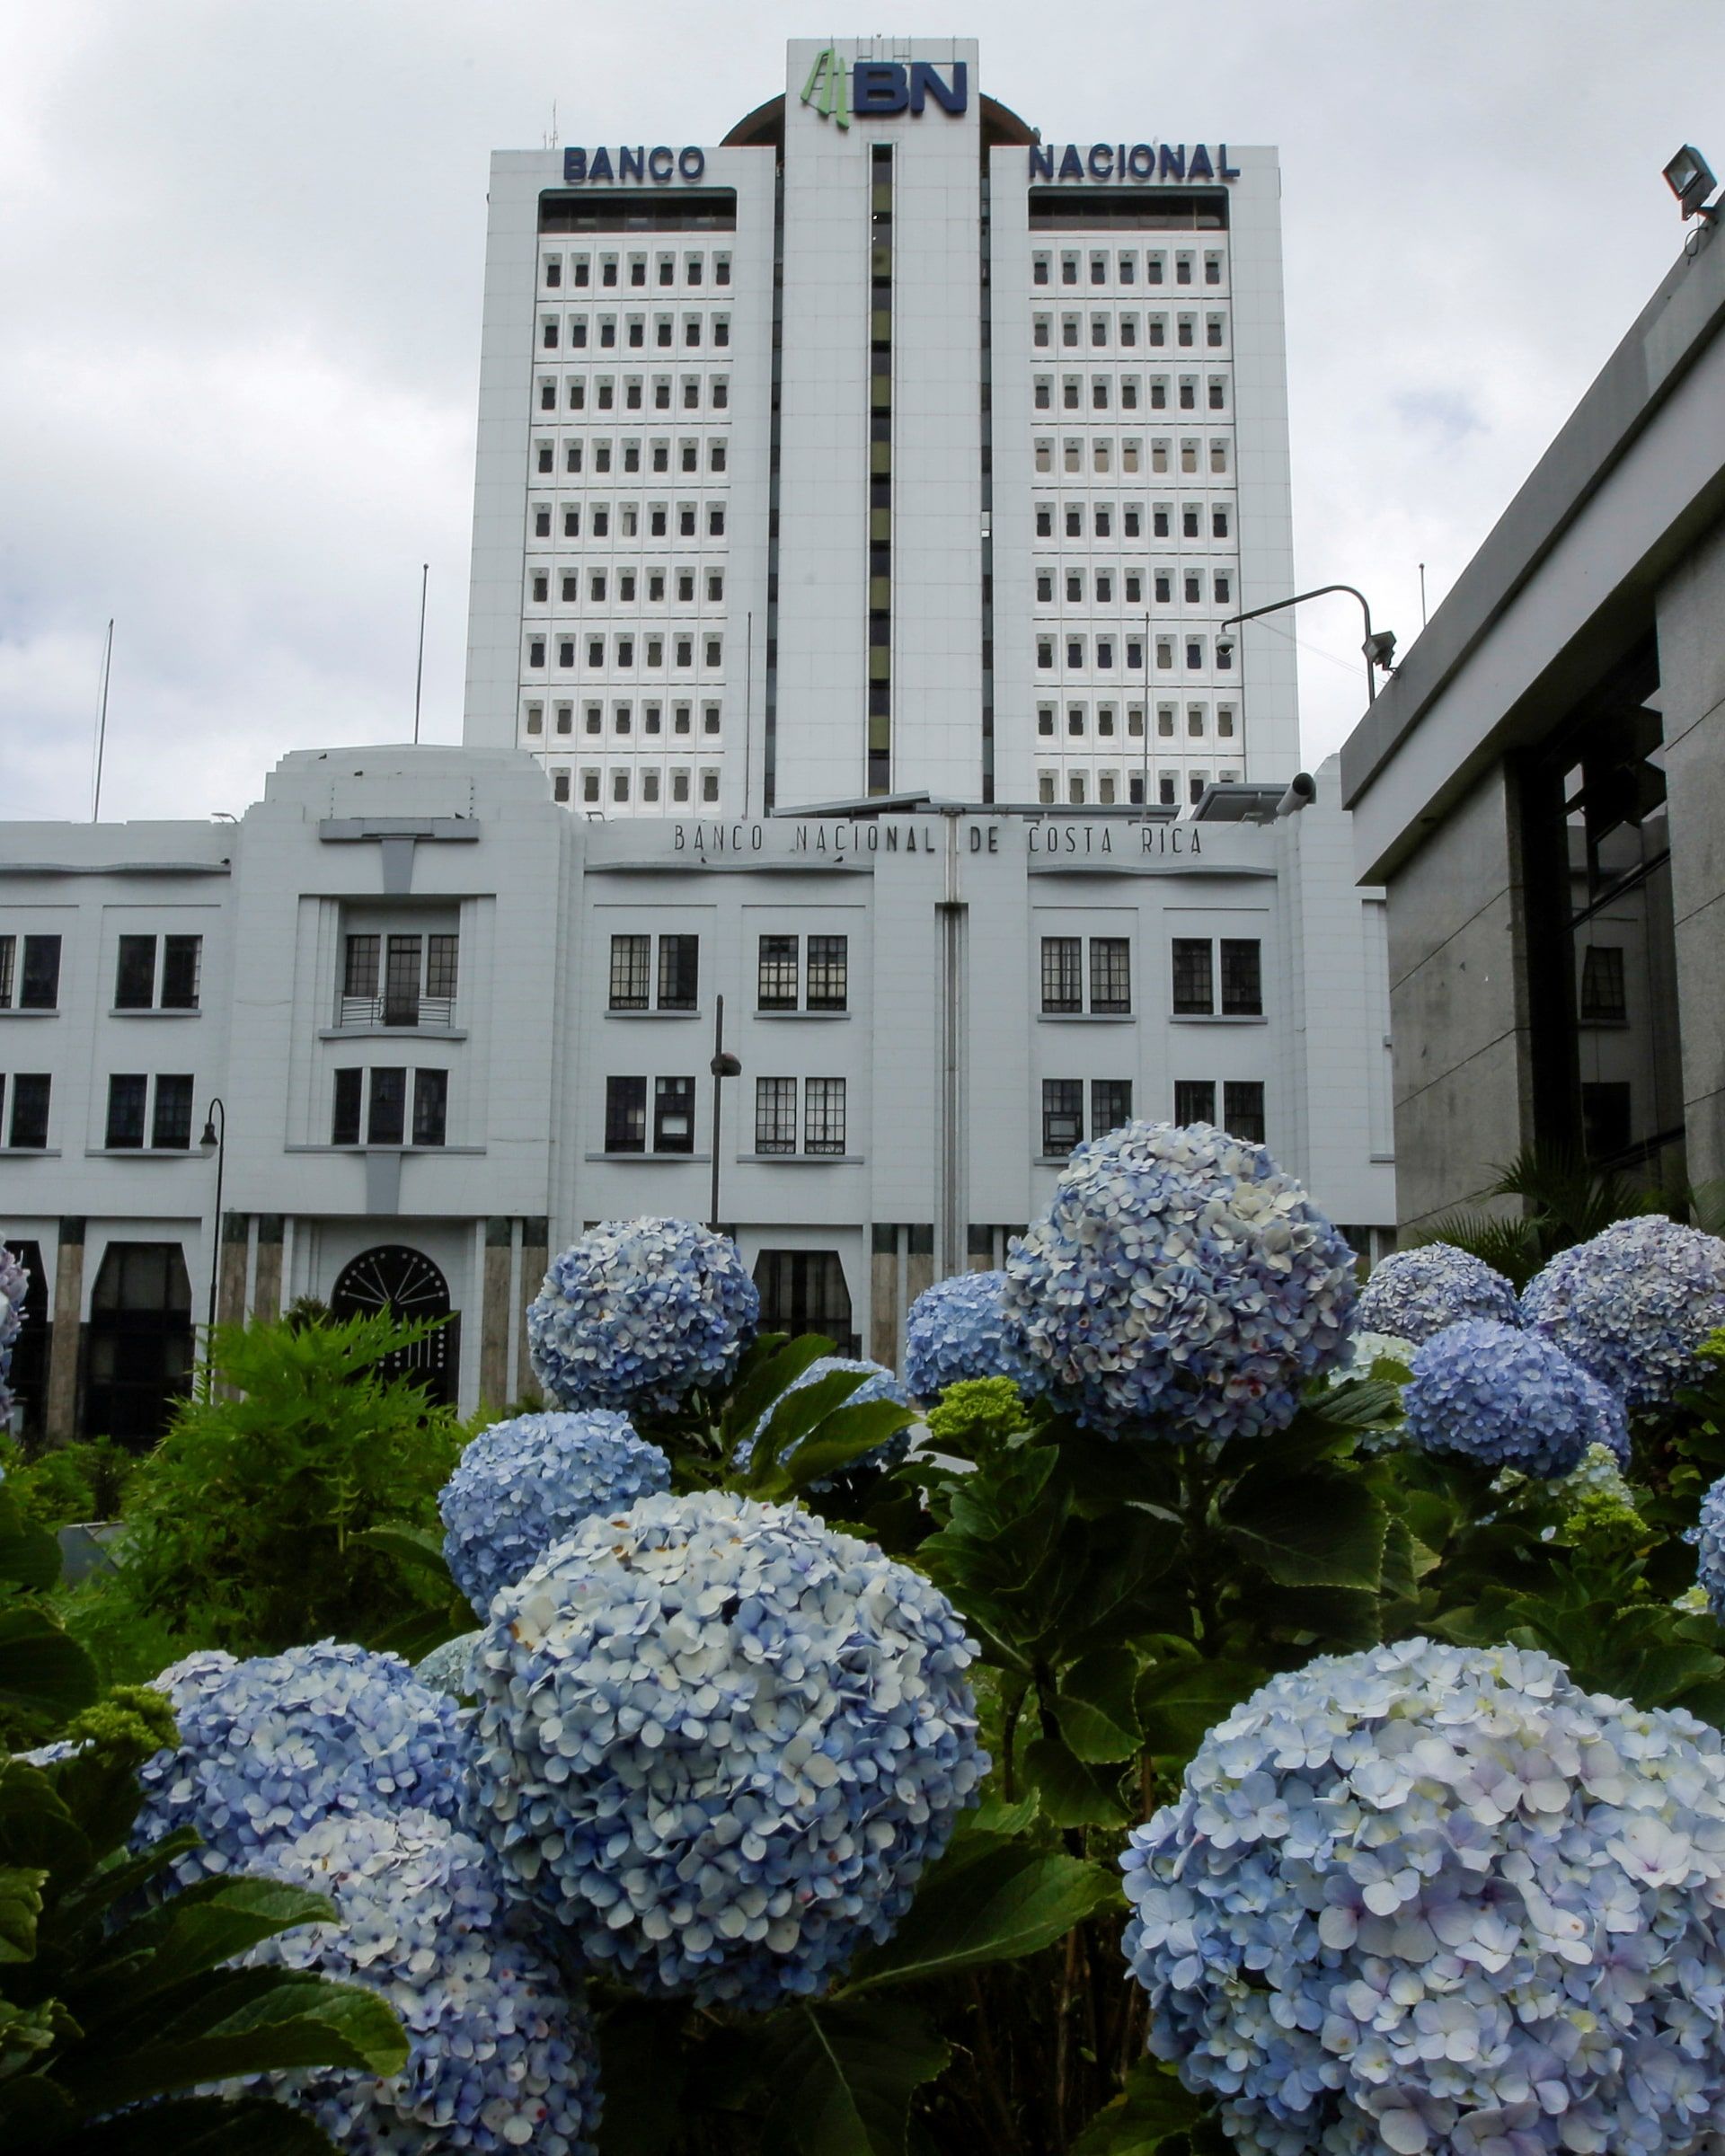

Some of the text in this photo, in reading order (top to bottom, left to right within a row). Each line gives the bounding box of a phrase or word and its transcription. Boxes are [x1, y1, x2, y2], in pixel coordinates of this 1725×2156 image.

[854, 63, 967, 114] BN
[563, 144, 1241, 184] BANCO NACIONAL
[674, 825, 1202, 853] BANCO NACIONAL DE COSTA RICA
